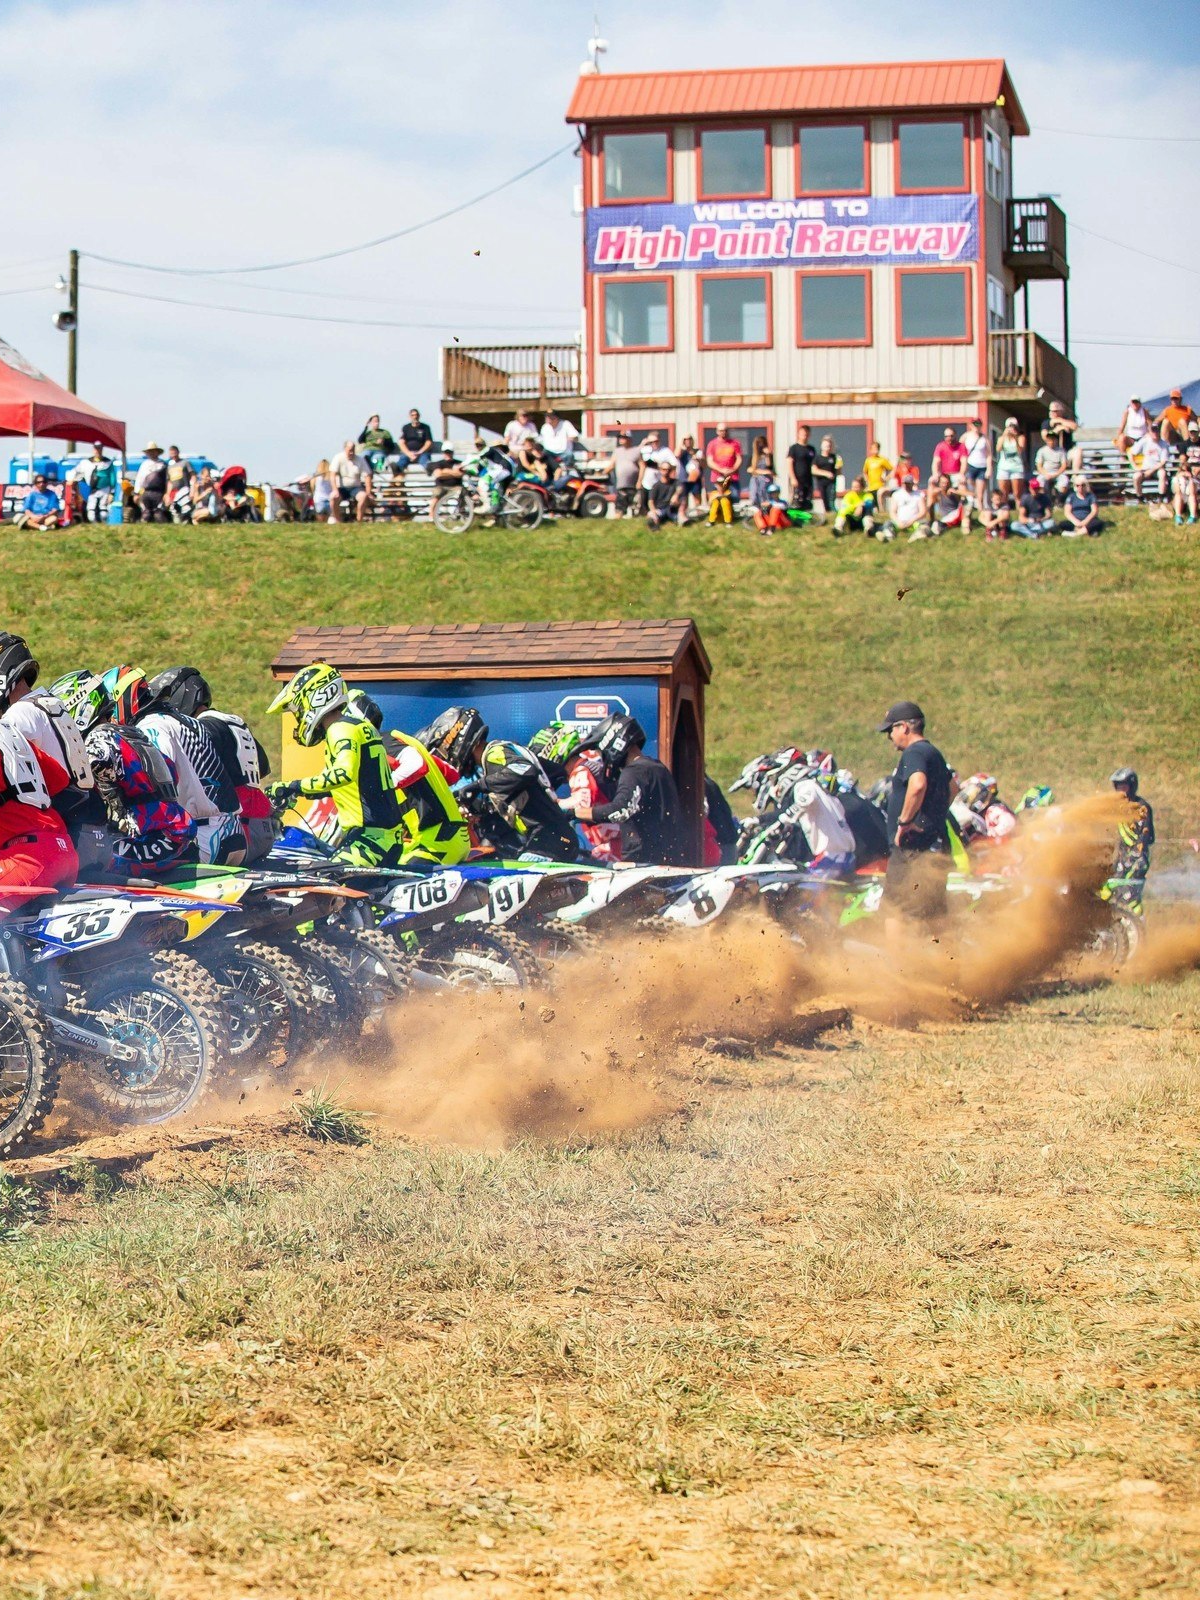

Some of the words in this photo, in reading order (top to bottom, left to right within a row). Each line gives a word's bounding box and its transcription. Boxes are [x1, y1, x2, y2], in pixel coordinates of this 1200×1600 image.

[694, 200, 825, 222] WELCOME
[831, 199, 869, 217] TO
[594, 225, 685, 268] High
[685, 221, 790, 260] Point
[790, 220, 971, 260] Raceway
[310, 768, 352, 789] FXR
[404, 878, 448, 910] 708
